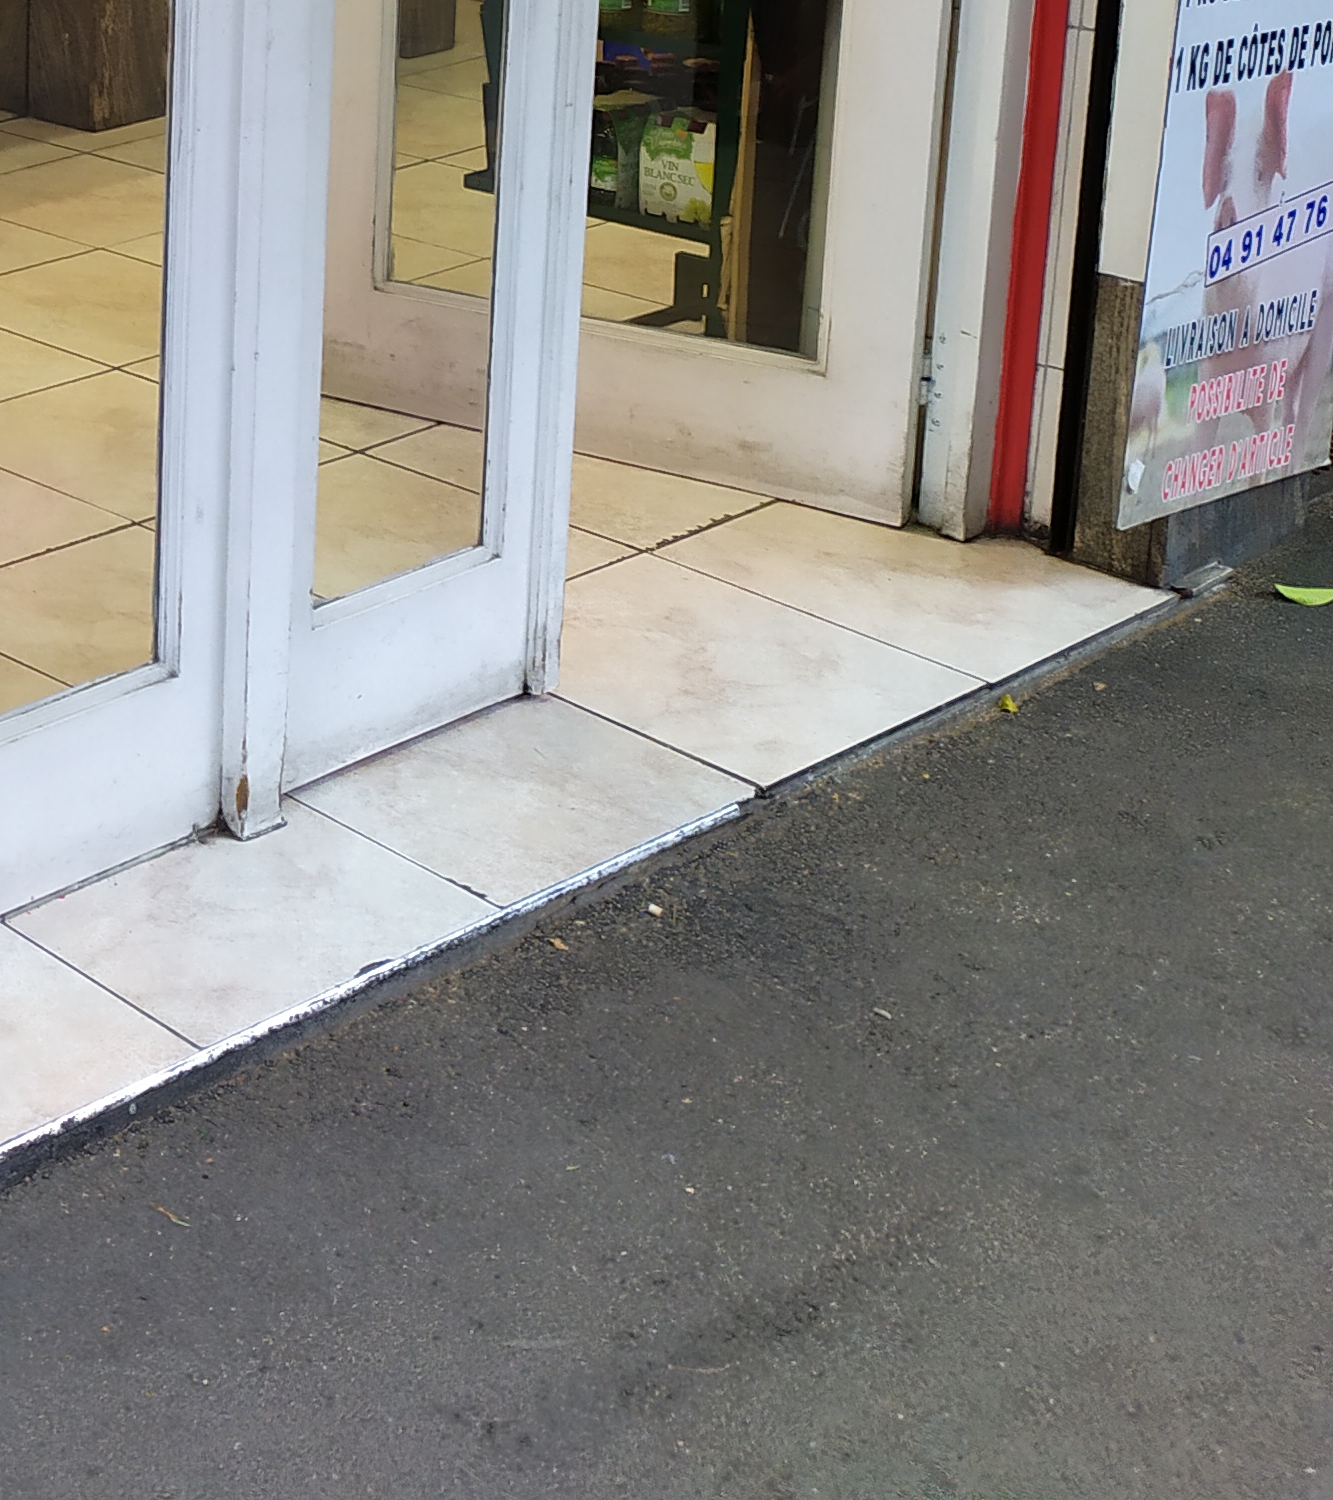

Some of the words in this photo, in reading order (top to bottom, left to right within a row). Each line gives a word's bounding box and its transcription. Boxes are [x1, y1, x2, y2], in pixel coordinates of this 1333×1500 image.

[1174, 45, 1185, 95] 1
[1186, 41, 1211, 93] KG
[1212, 36, 1235, 88] DE
[1237, 22, 1287, 83] CÔTES
[1288, 24, 1310, 73] DE
[661, 159, 680, 172] VIN
[1208, 243, 1234, 280] 04
[1240, 223, 1265, 265] 91
[1271, 207, 1299, 247] 47
[1304, 195, 1329, 234] 76
[1163, 316, 1236, 371] LIVRAISON
[1239, 312, 1251, 344] A
[1255, 289, 1319, 342] DOMICILE
[1267, 358, 1289, 403] DE
[1161, 444, 1224, 503] CHANGER
[1225, 423, 1296, 485] D'ARTICLE
